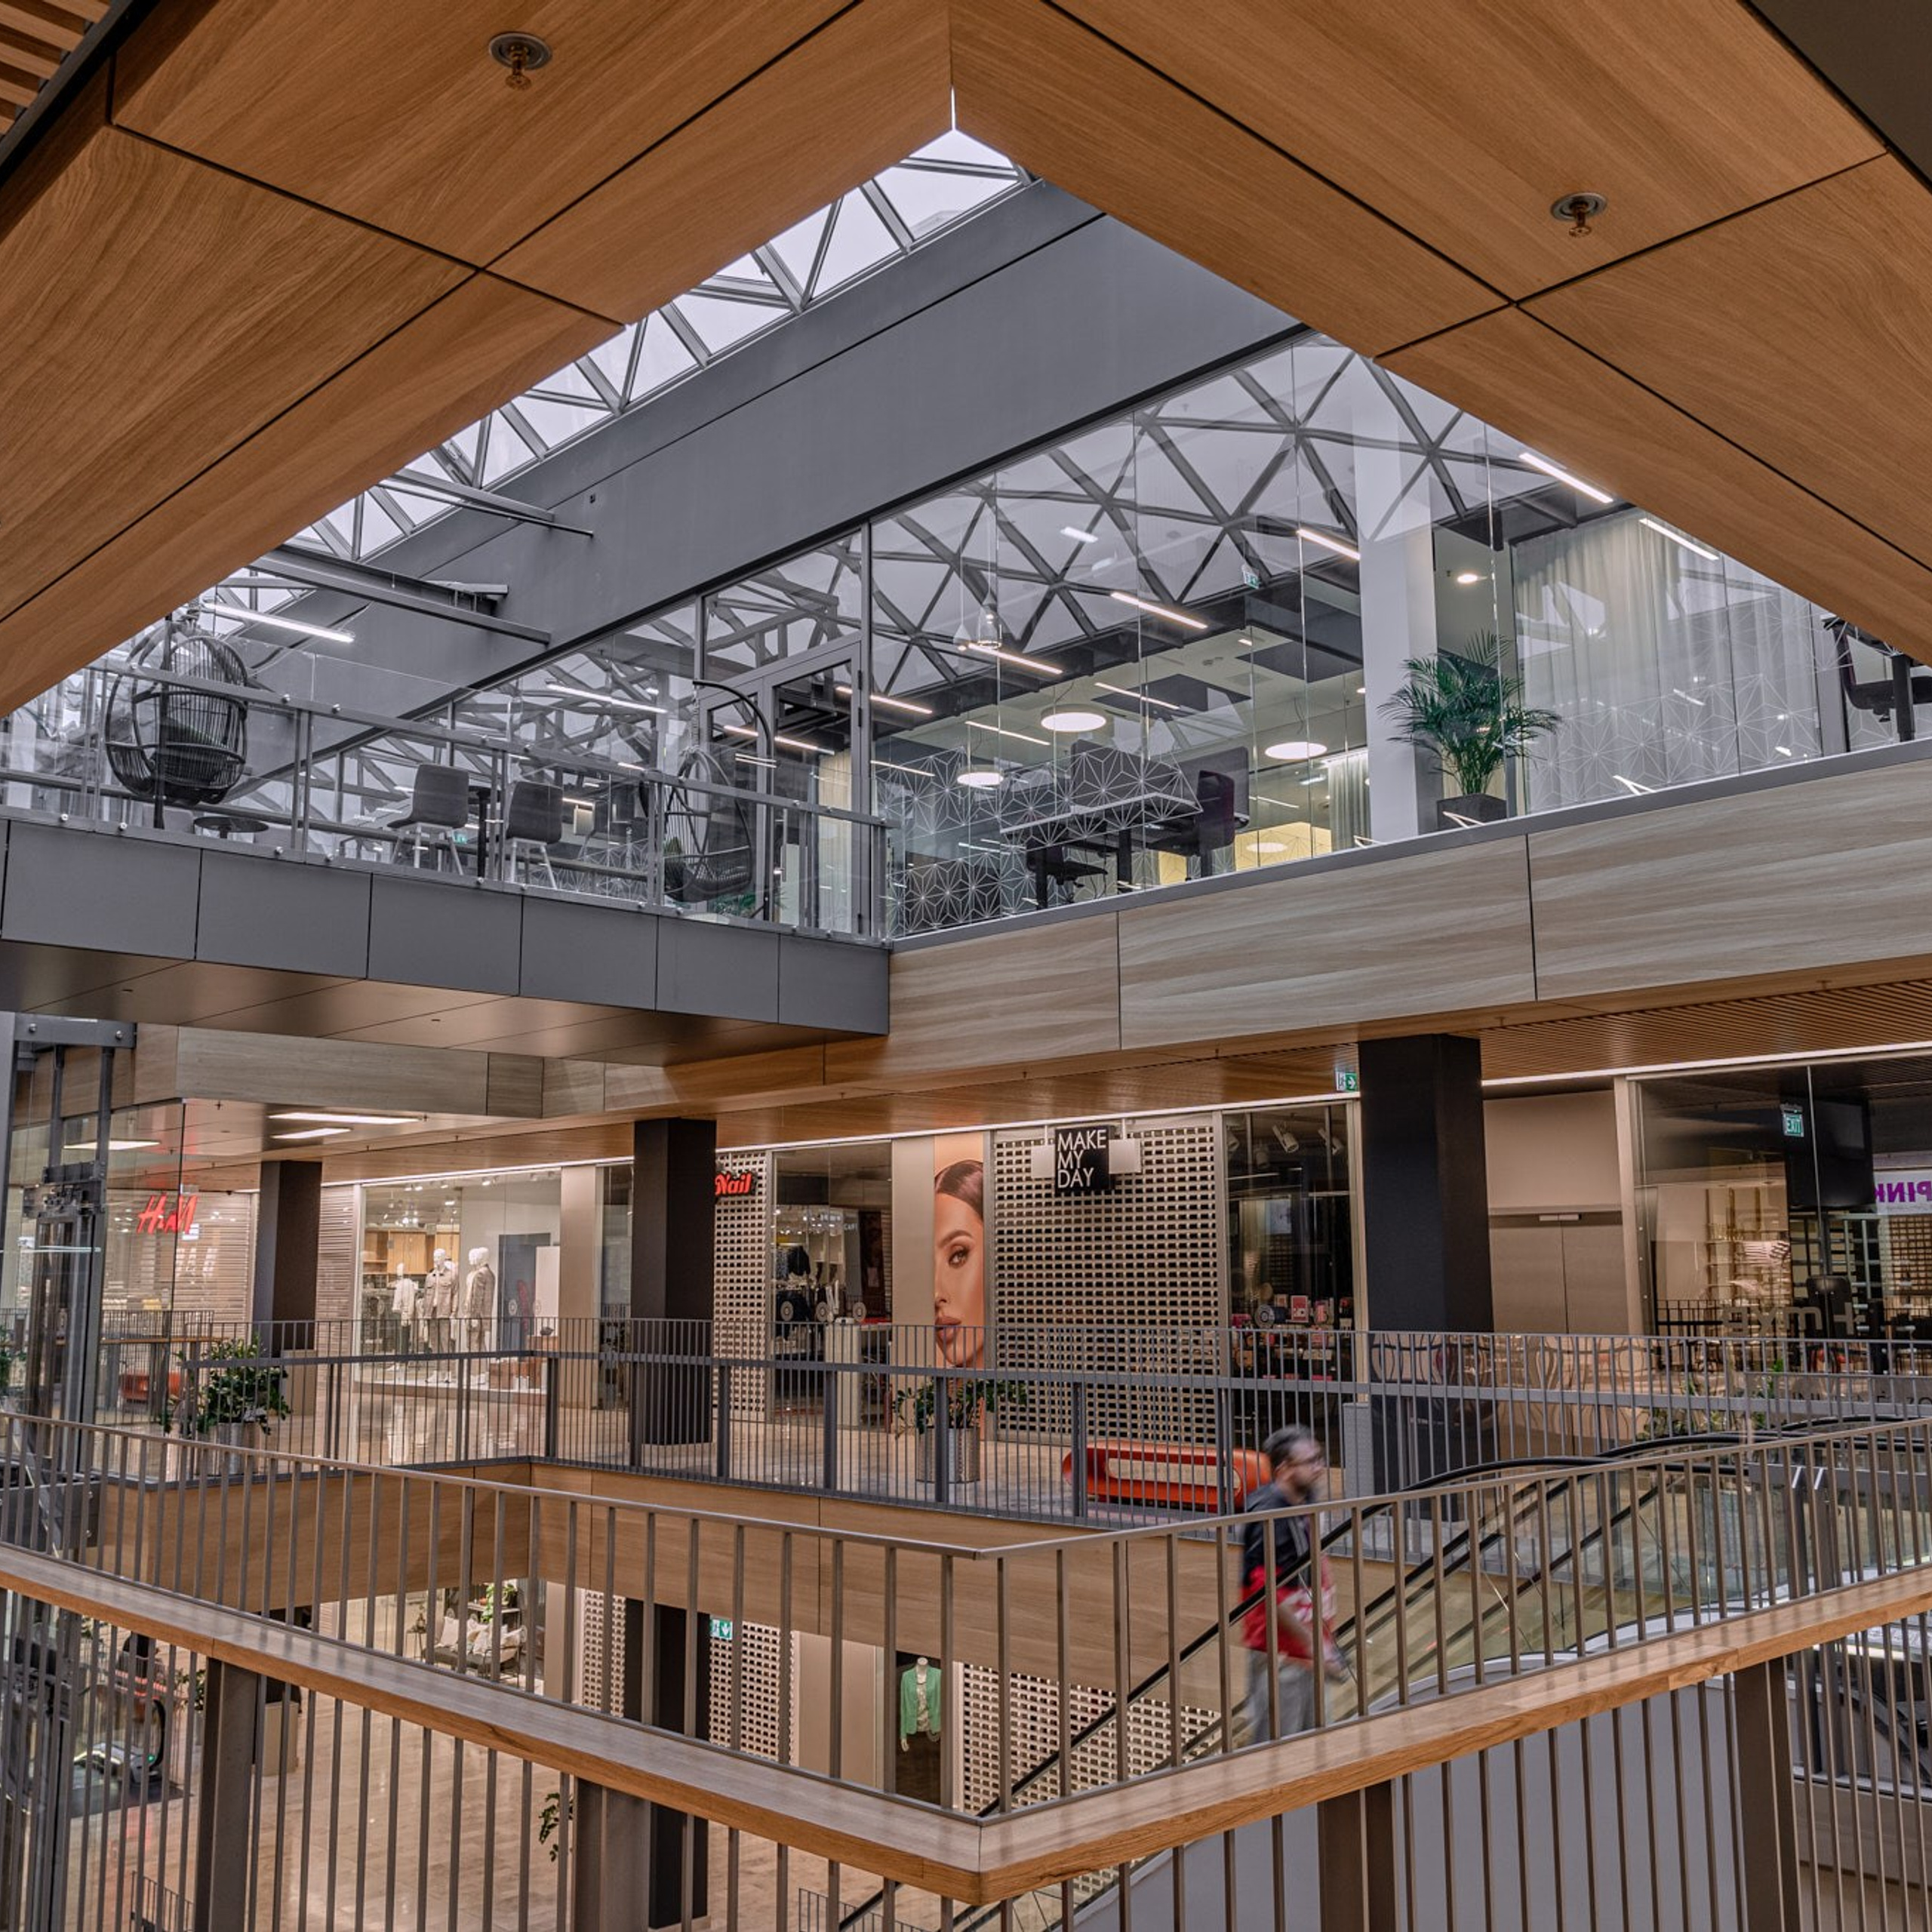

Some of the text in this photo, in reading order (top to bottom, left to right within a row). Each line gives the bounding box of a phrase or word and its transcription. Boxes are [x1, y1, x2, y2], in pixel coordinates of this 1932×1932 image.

[1057, 1129, 1107, 1152] MAKE
[1057, 1149, 1084, 1169] MY
[715, 1173, 752, 1195] Nail
[1057, 1168, 1094, 1189] DAY
[137, 1195, 197, 1234] H&M
